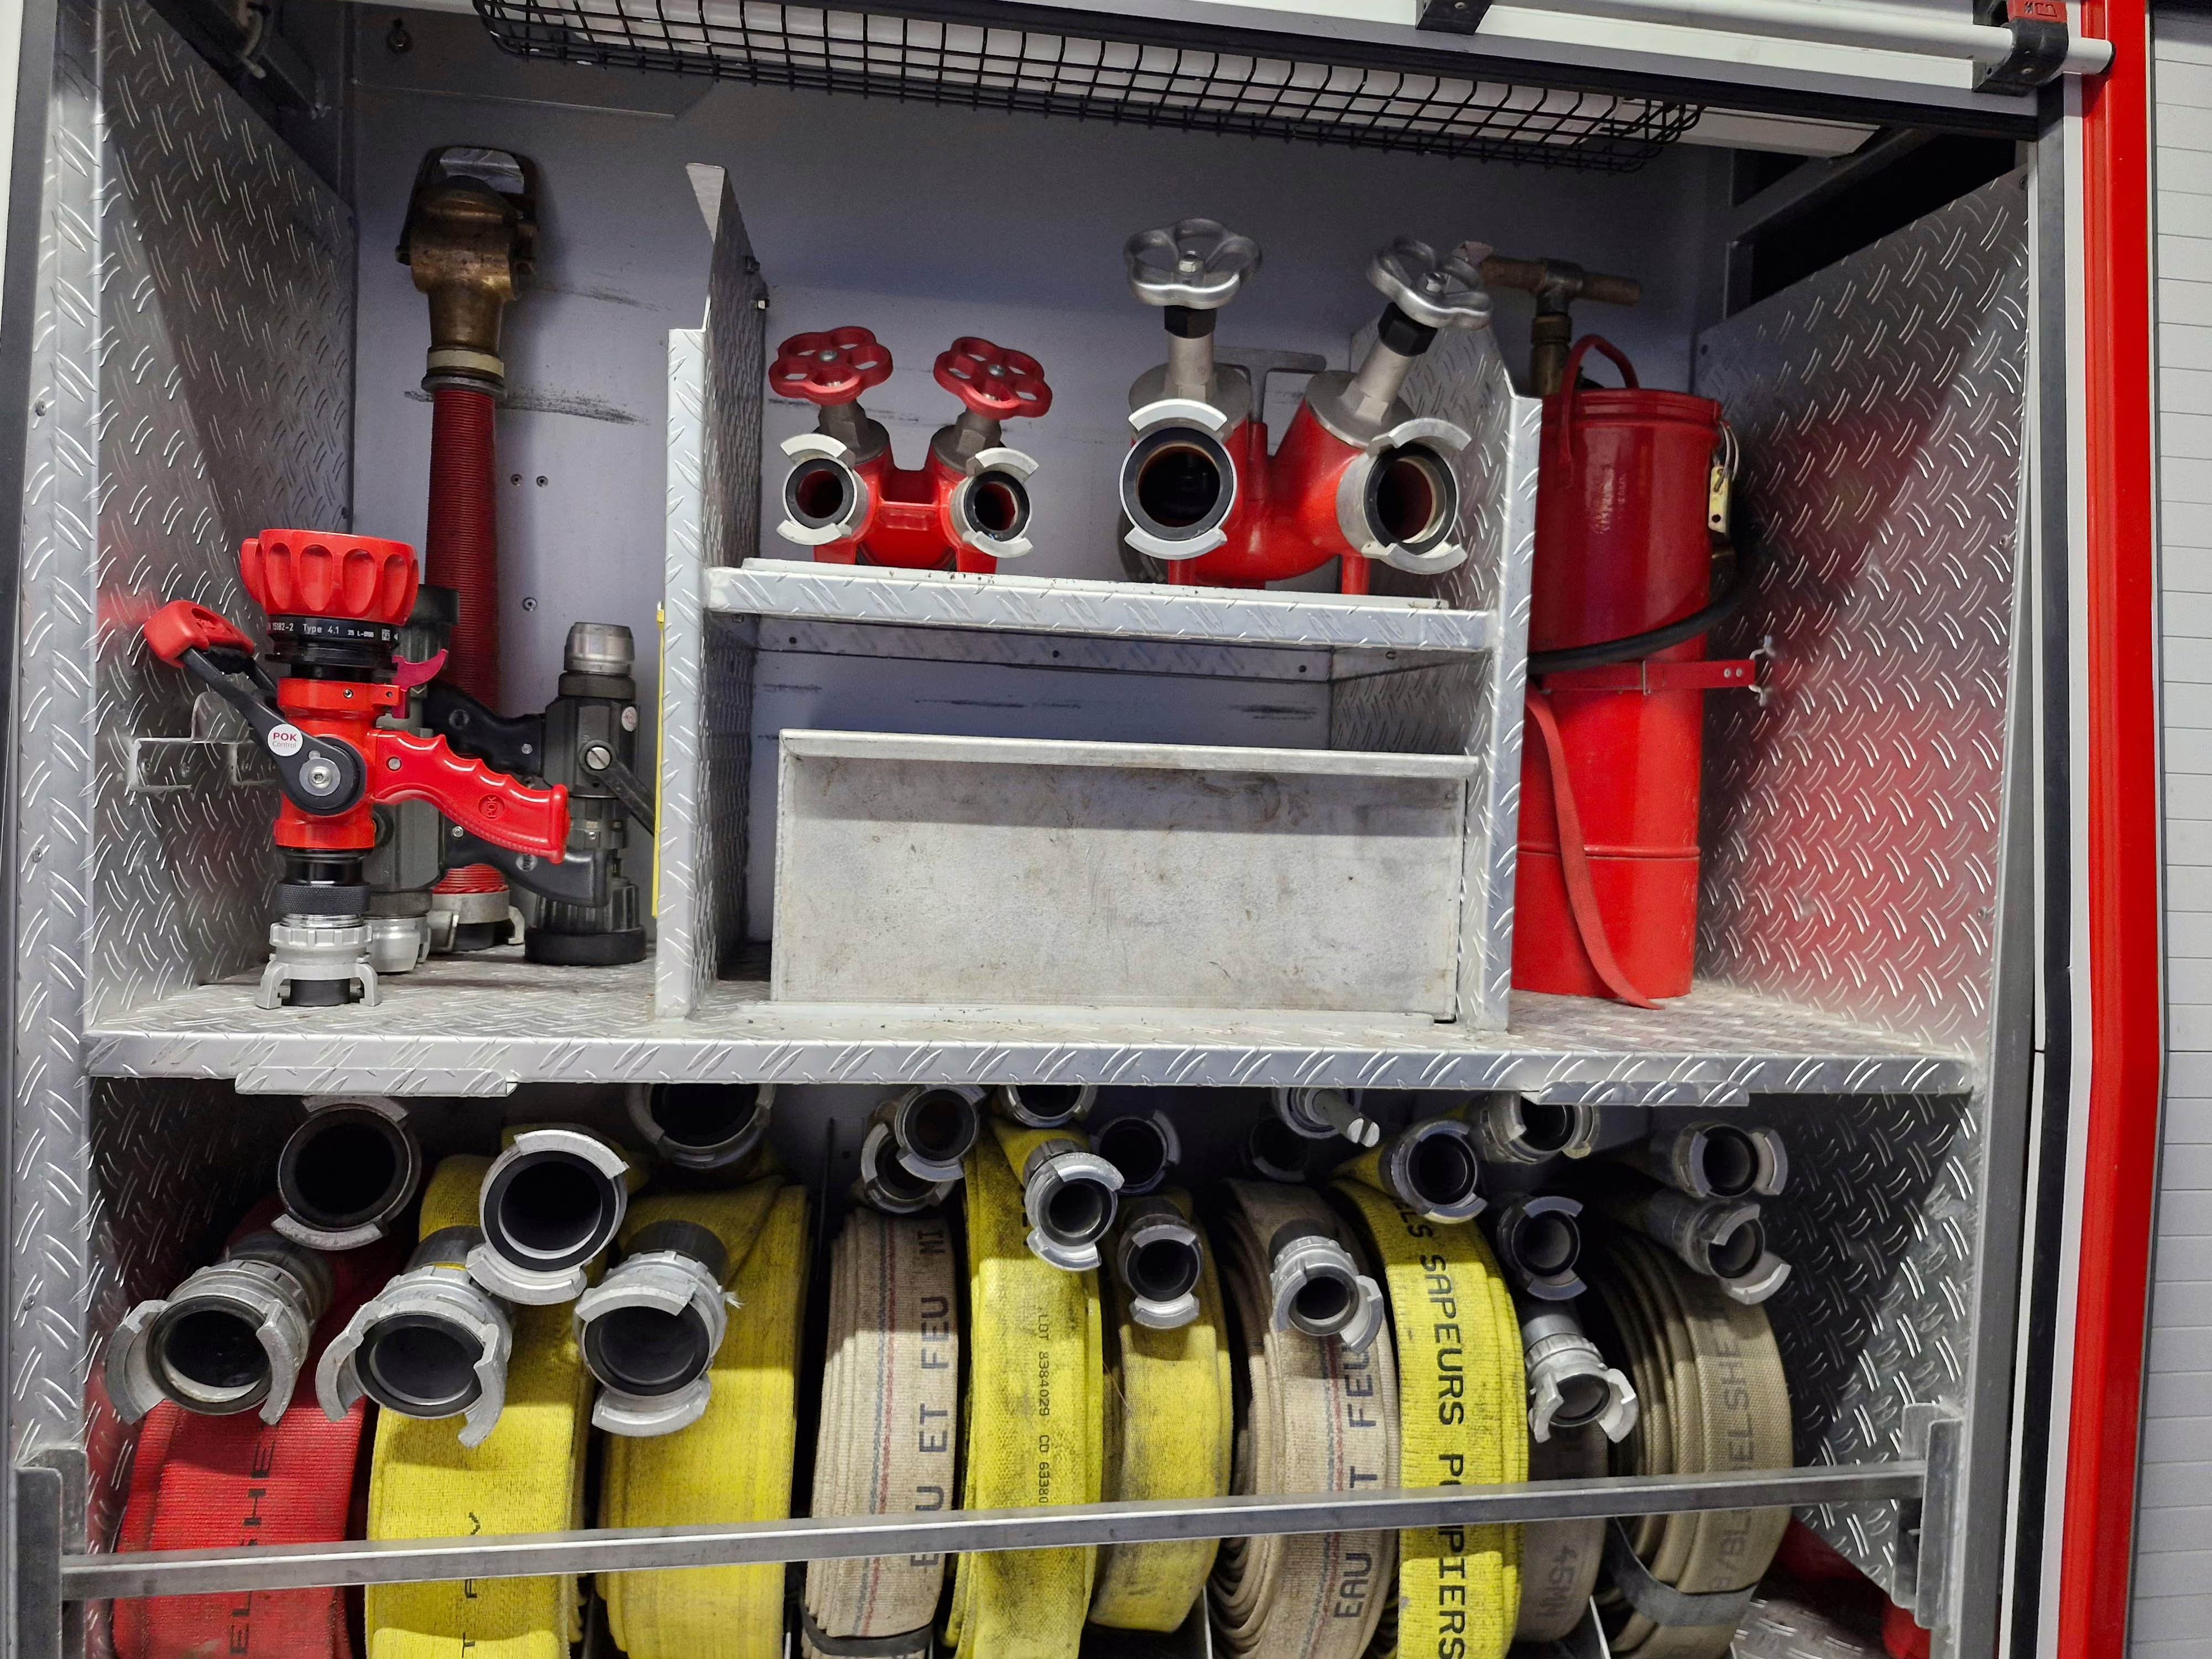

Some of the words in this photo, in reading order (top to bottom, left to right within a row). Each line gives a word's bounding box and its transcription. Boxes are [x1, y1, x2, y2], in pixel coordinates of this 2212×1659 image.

[303, 624, 322, 634] Type
[327, 627, 340, 635] 4.1
[273, 732, 297, 742] POK
[487, 796, 497, 818] POK
[921, 1295, 950, 1369] FEU
[1039, 1314, 1049, 1340] LOT
[1420, 1254, 1464, 1425] SAPEURS
[1039, 1351, 1050, 1416] 8384029
[1342, 1345, 1376, 1427] FEU
[919, 1404, 948, 1453] ET
[1039, 1434, 1050, 1452] CD
[1039, 1462, 1050, 1504] 63380
[1438, 1454, 1465, 1659] PPIERS
[1334, 1552, 1373, 1619] EAU
